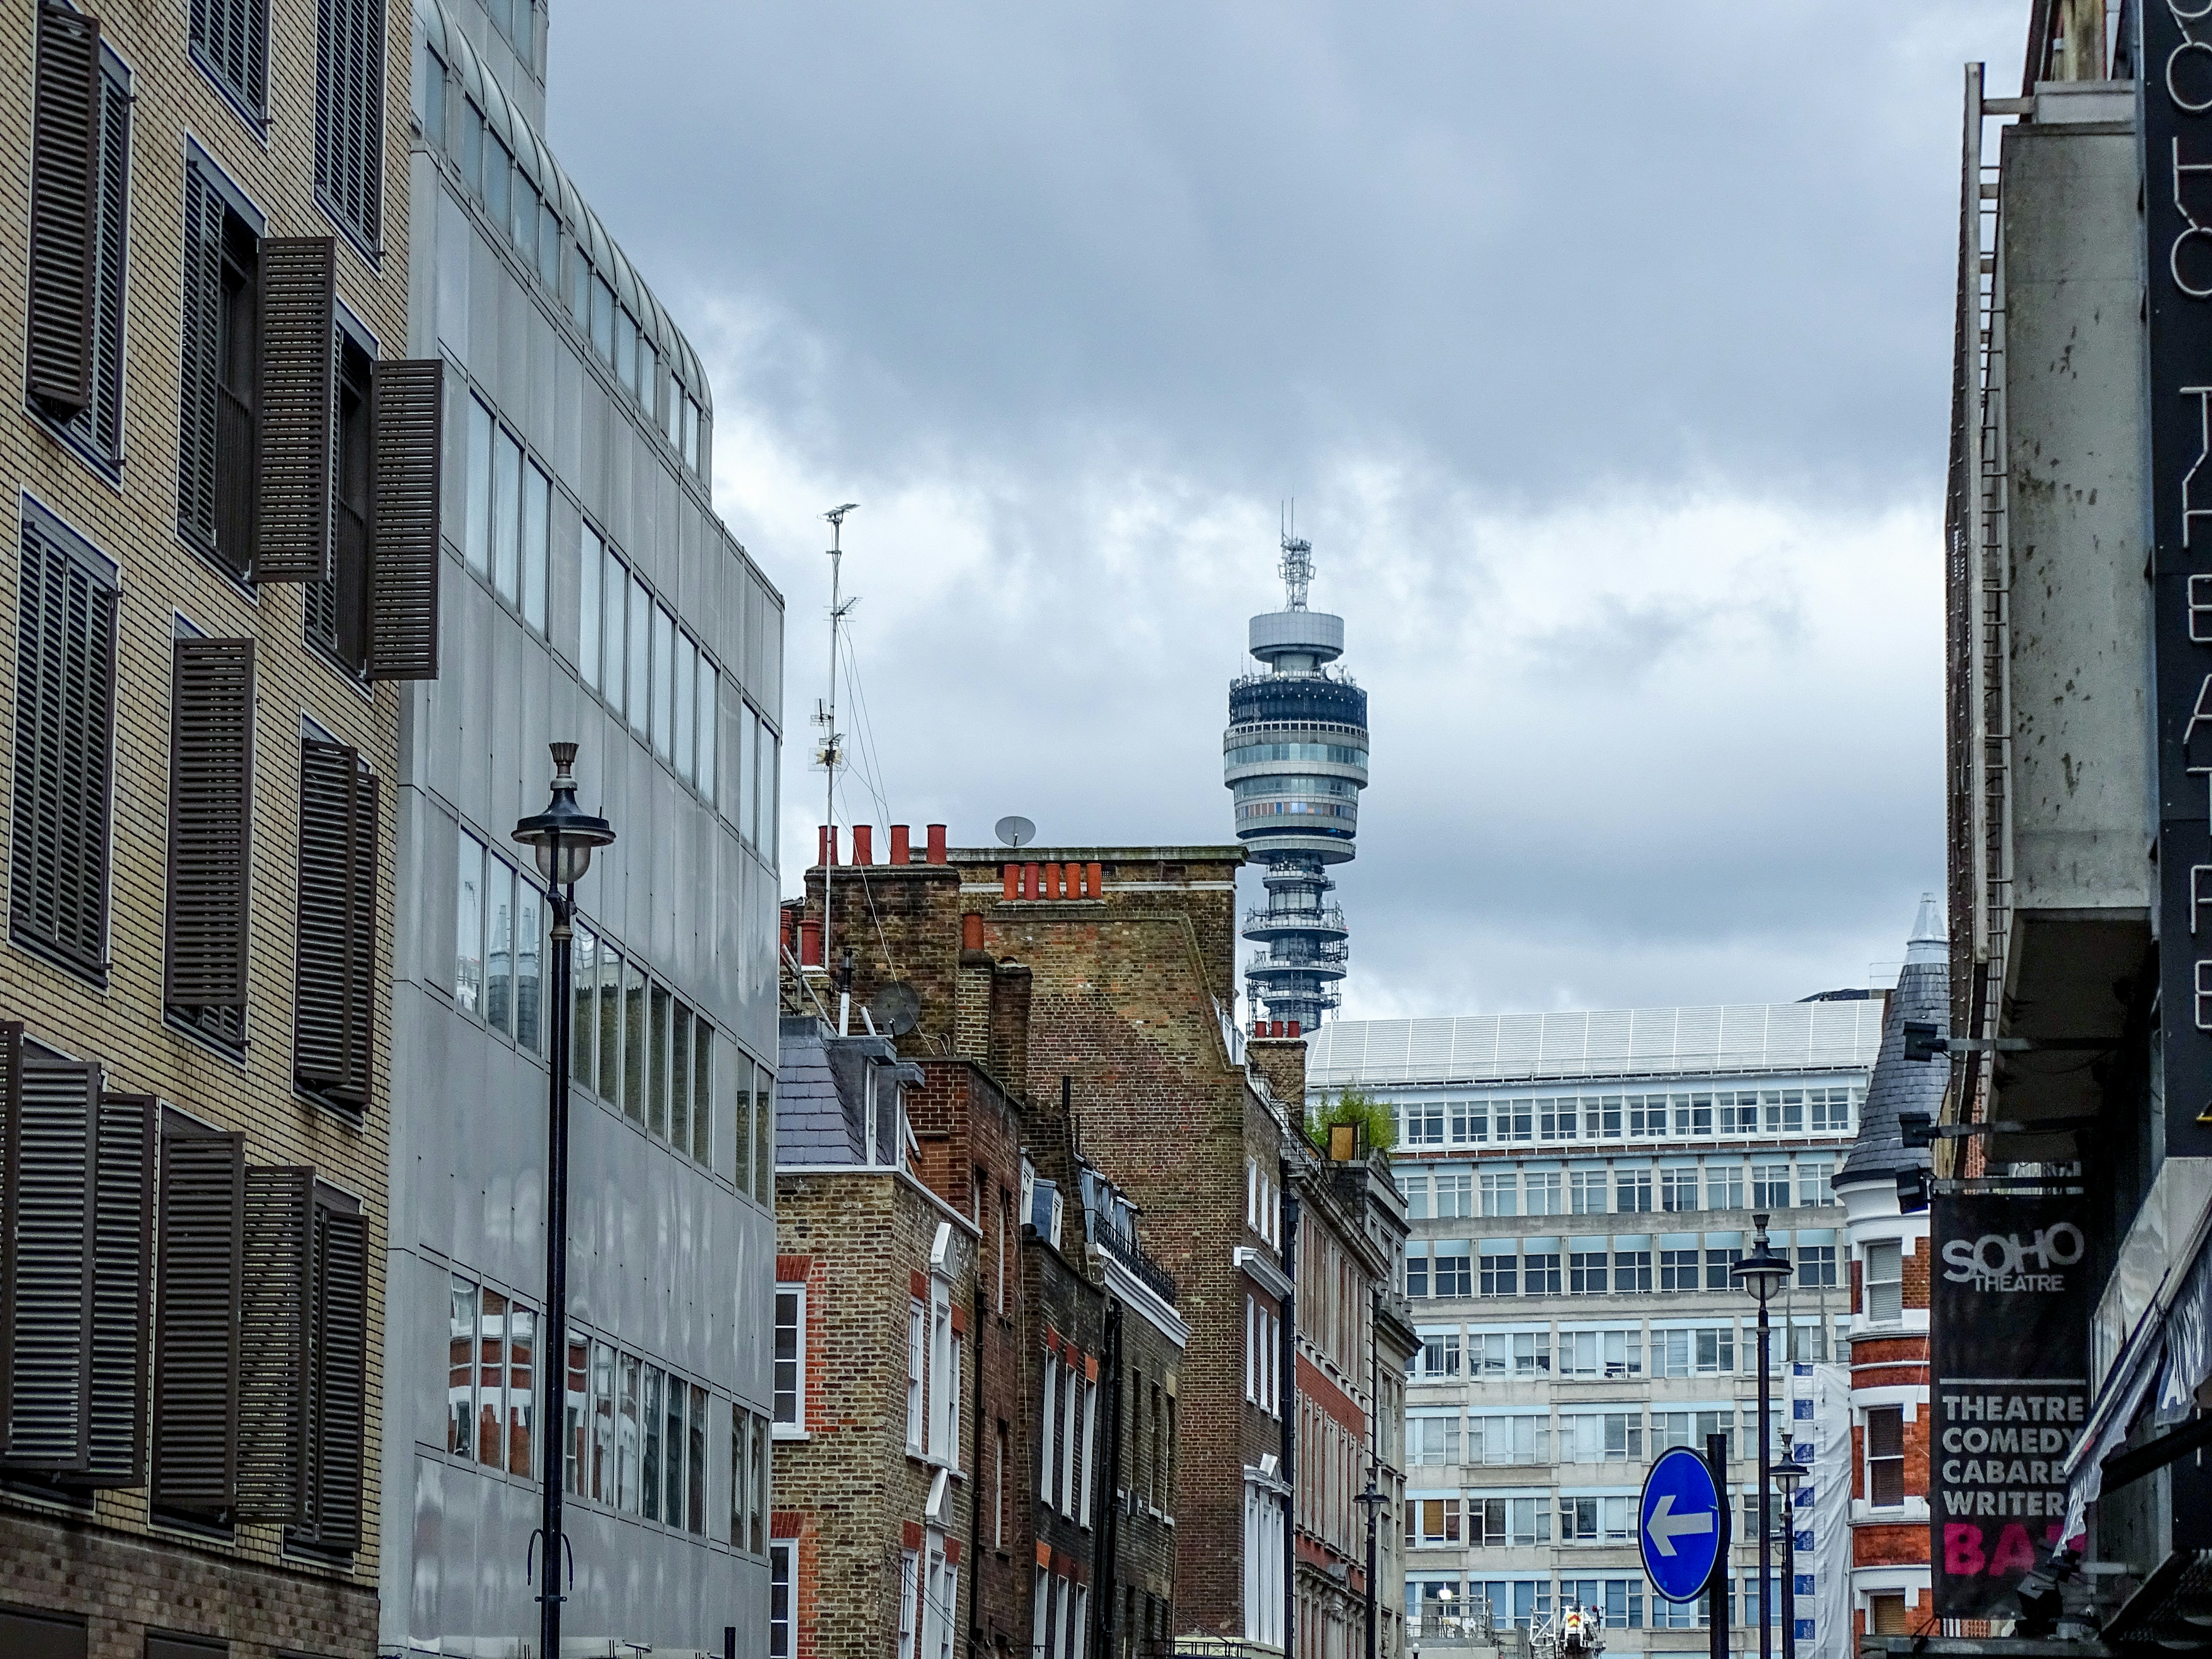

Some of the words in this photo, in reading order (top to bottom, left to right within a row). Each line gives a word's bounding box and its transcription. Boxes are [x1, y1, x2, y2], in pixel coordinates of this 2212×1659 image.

[2166, 0, 2212, 295] OHO
[1942, 1222, 2084, 1283] SOHO
[1971, 1274, 2064, 1292] THEATRE
[1942, 1396, 2084, 1421] THEATRE
